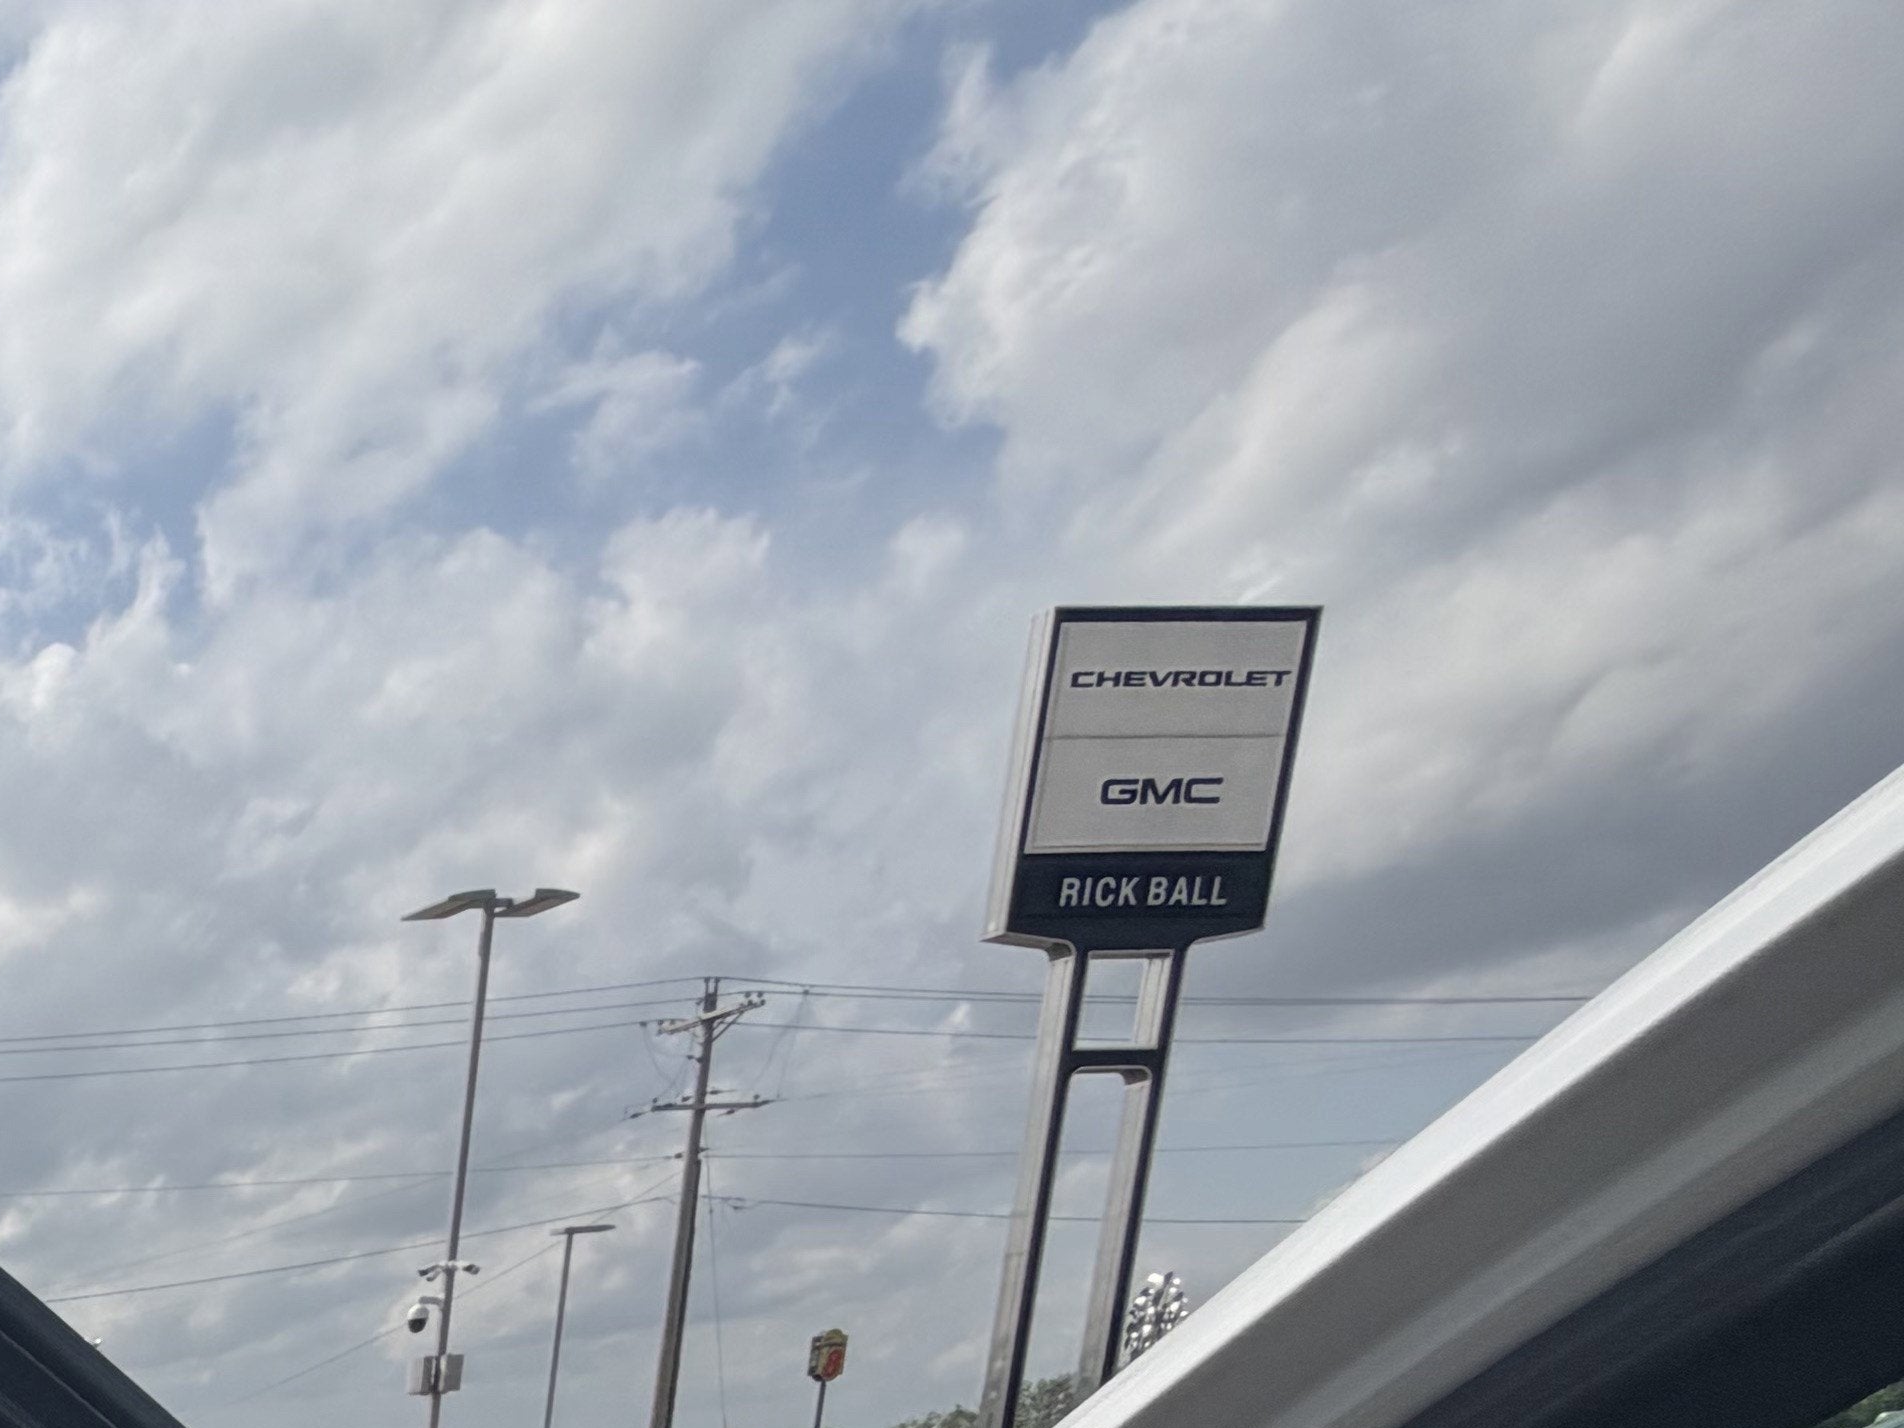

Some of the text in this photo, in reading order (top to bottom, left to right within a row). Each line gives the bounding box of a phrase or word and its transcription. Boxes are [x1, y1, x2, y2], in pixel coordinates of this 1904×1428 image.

[1070, 670, 1292, 688] CHEVROLET
[1100, 777, 1224, 805] GMC
[1059, 875, 1228, 907] RICK BALL
